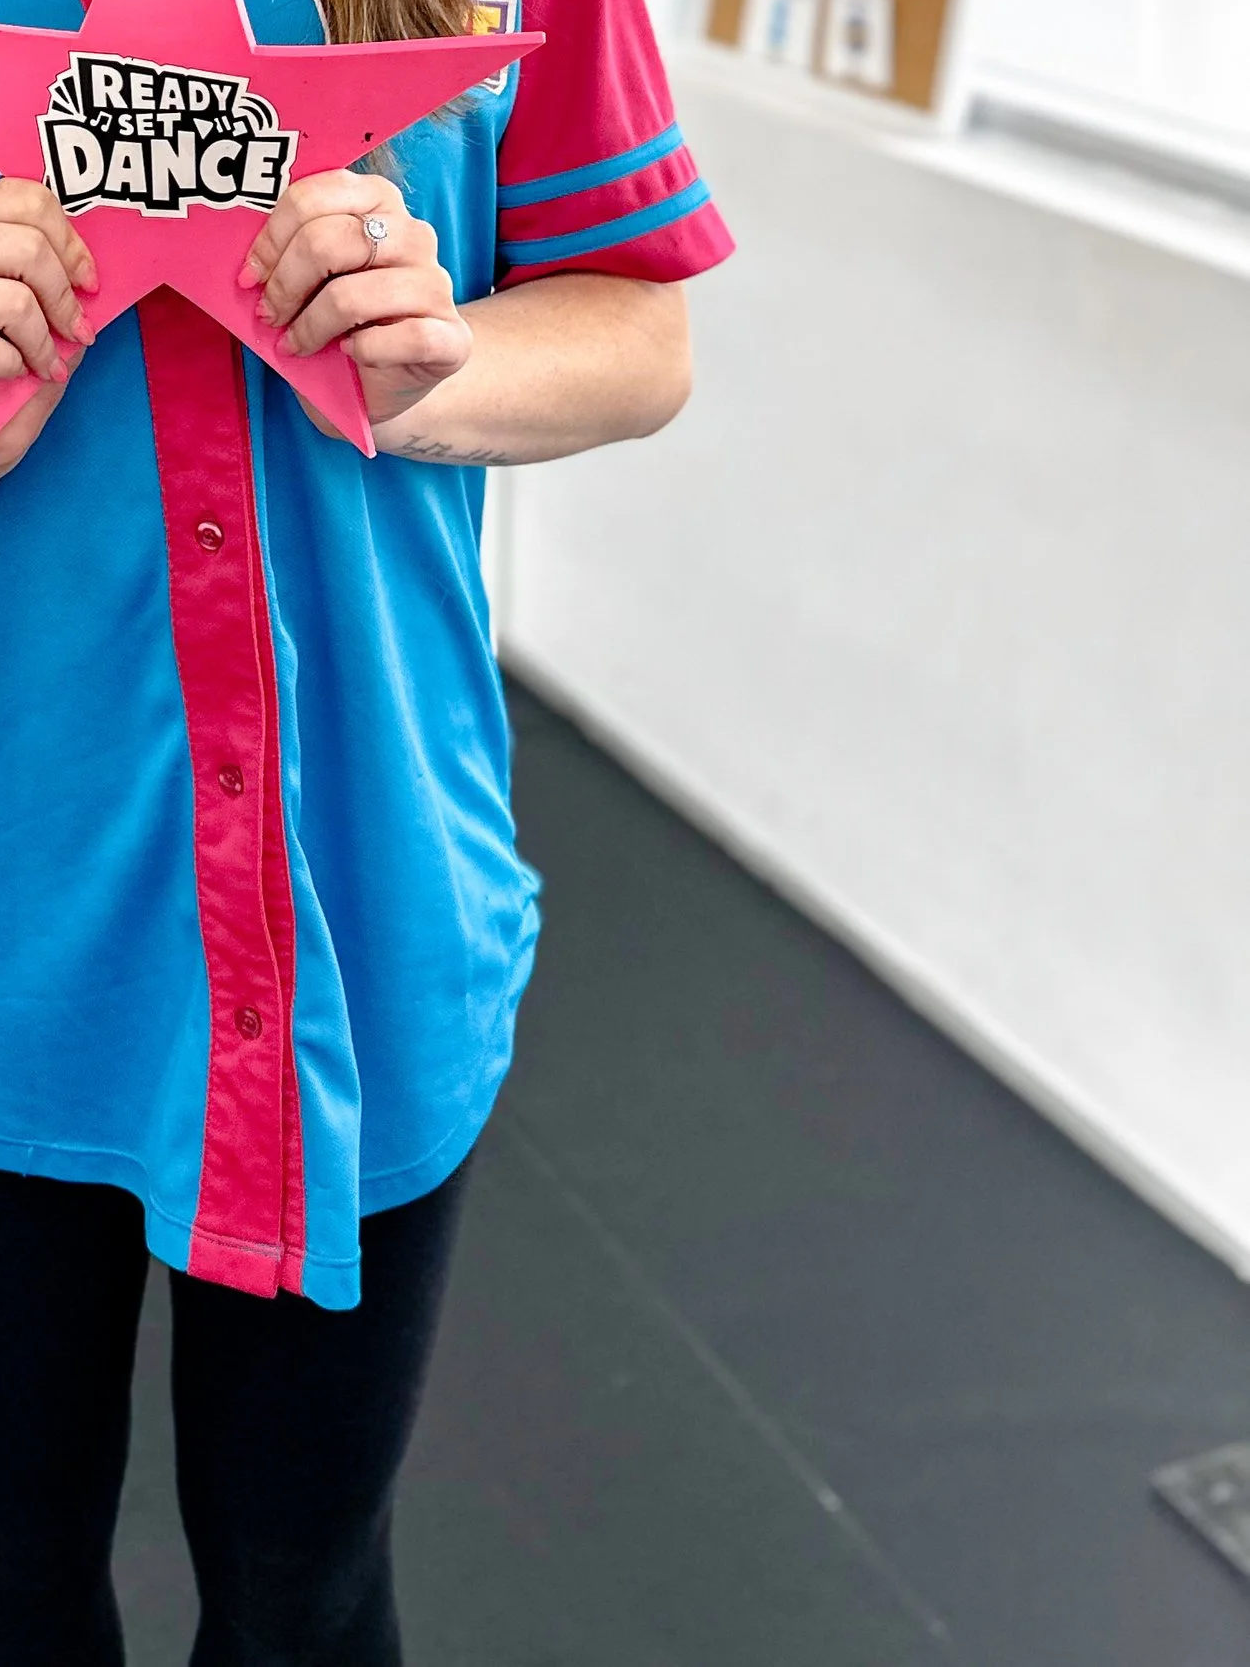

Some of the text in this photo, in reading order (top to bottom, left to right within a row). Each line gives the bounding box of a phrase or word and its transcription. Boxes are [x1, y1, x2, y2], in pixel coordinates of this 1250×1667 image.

[90, 64, 232, 111] READY
[118, 112, 181, 137] SET
[53, 124, 281, 202] DANCE
